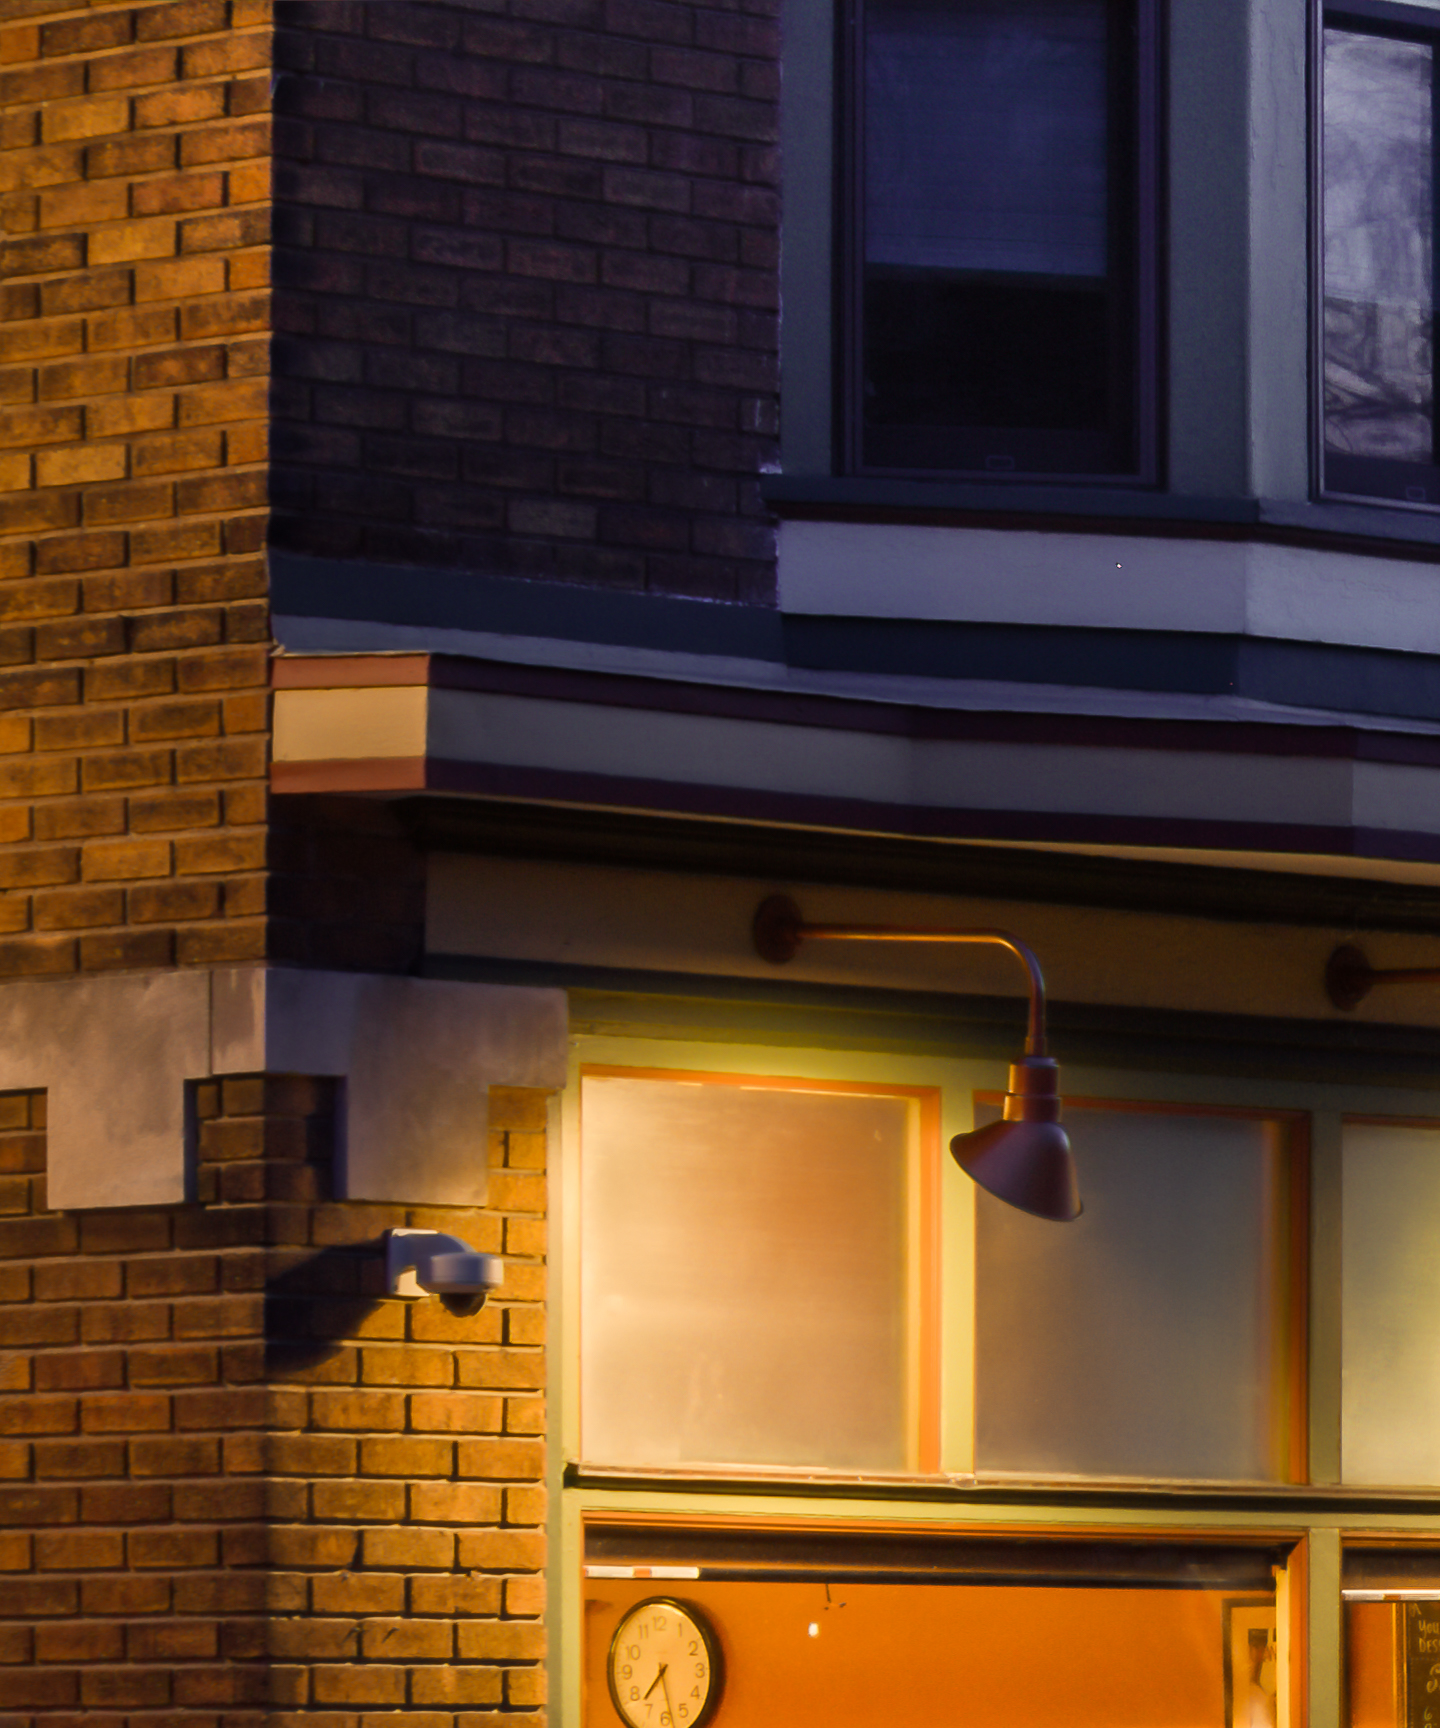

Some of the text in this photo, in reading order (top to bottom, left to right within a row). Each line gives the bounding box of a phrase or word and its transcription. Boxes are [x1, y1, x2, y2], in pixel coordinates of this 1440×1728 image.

[653, 1616, 667, 1631] 12
[639, 1625, 649, 1639] 11
[626, 1645, 641, 1660] 10
[689, 1641, 698, 1656] 2
[622, 1665, 633, 1680] 9
[695, 1663, 705, 1678] 3
[630, 1686, 640, 1701] 8
[691, 1685, 700, 1700] 4
[645, 1704, 653, 1718] 7
[660, 1711, 671, 1726] 6
[678, 1704, 689, 1718] 5
